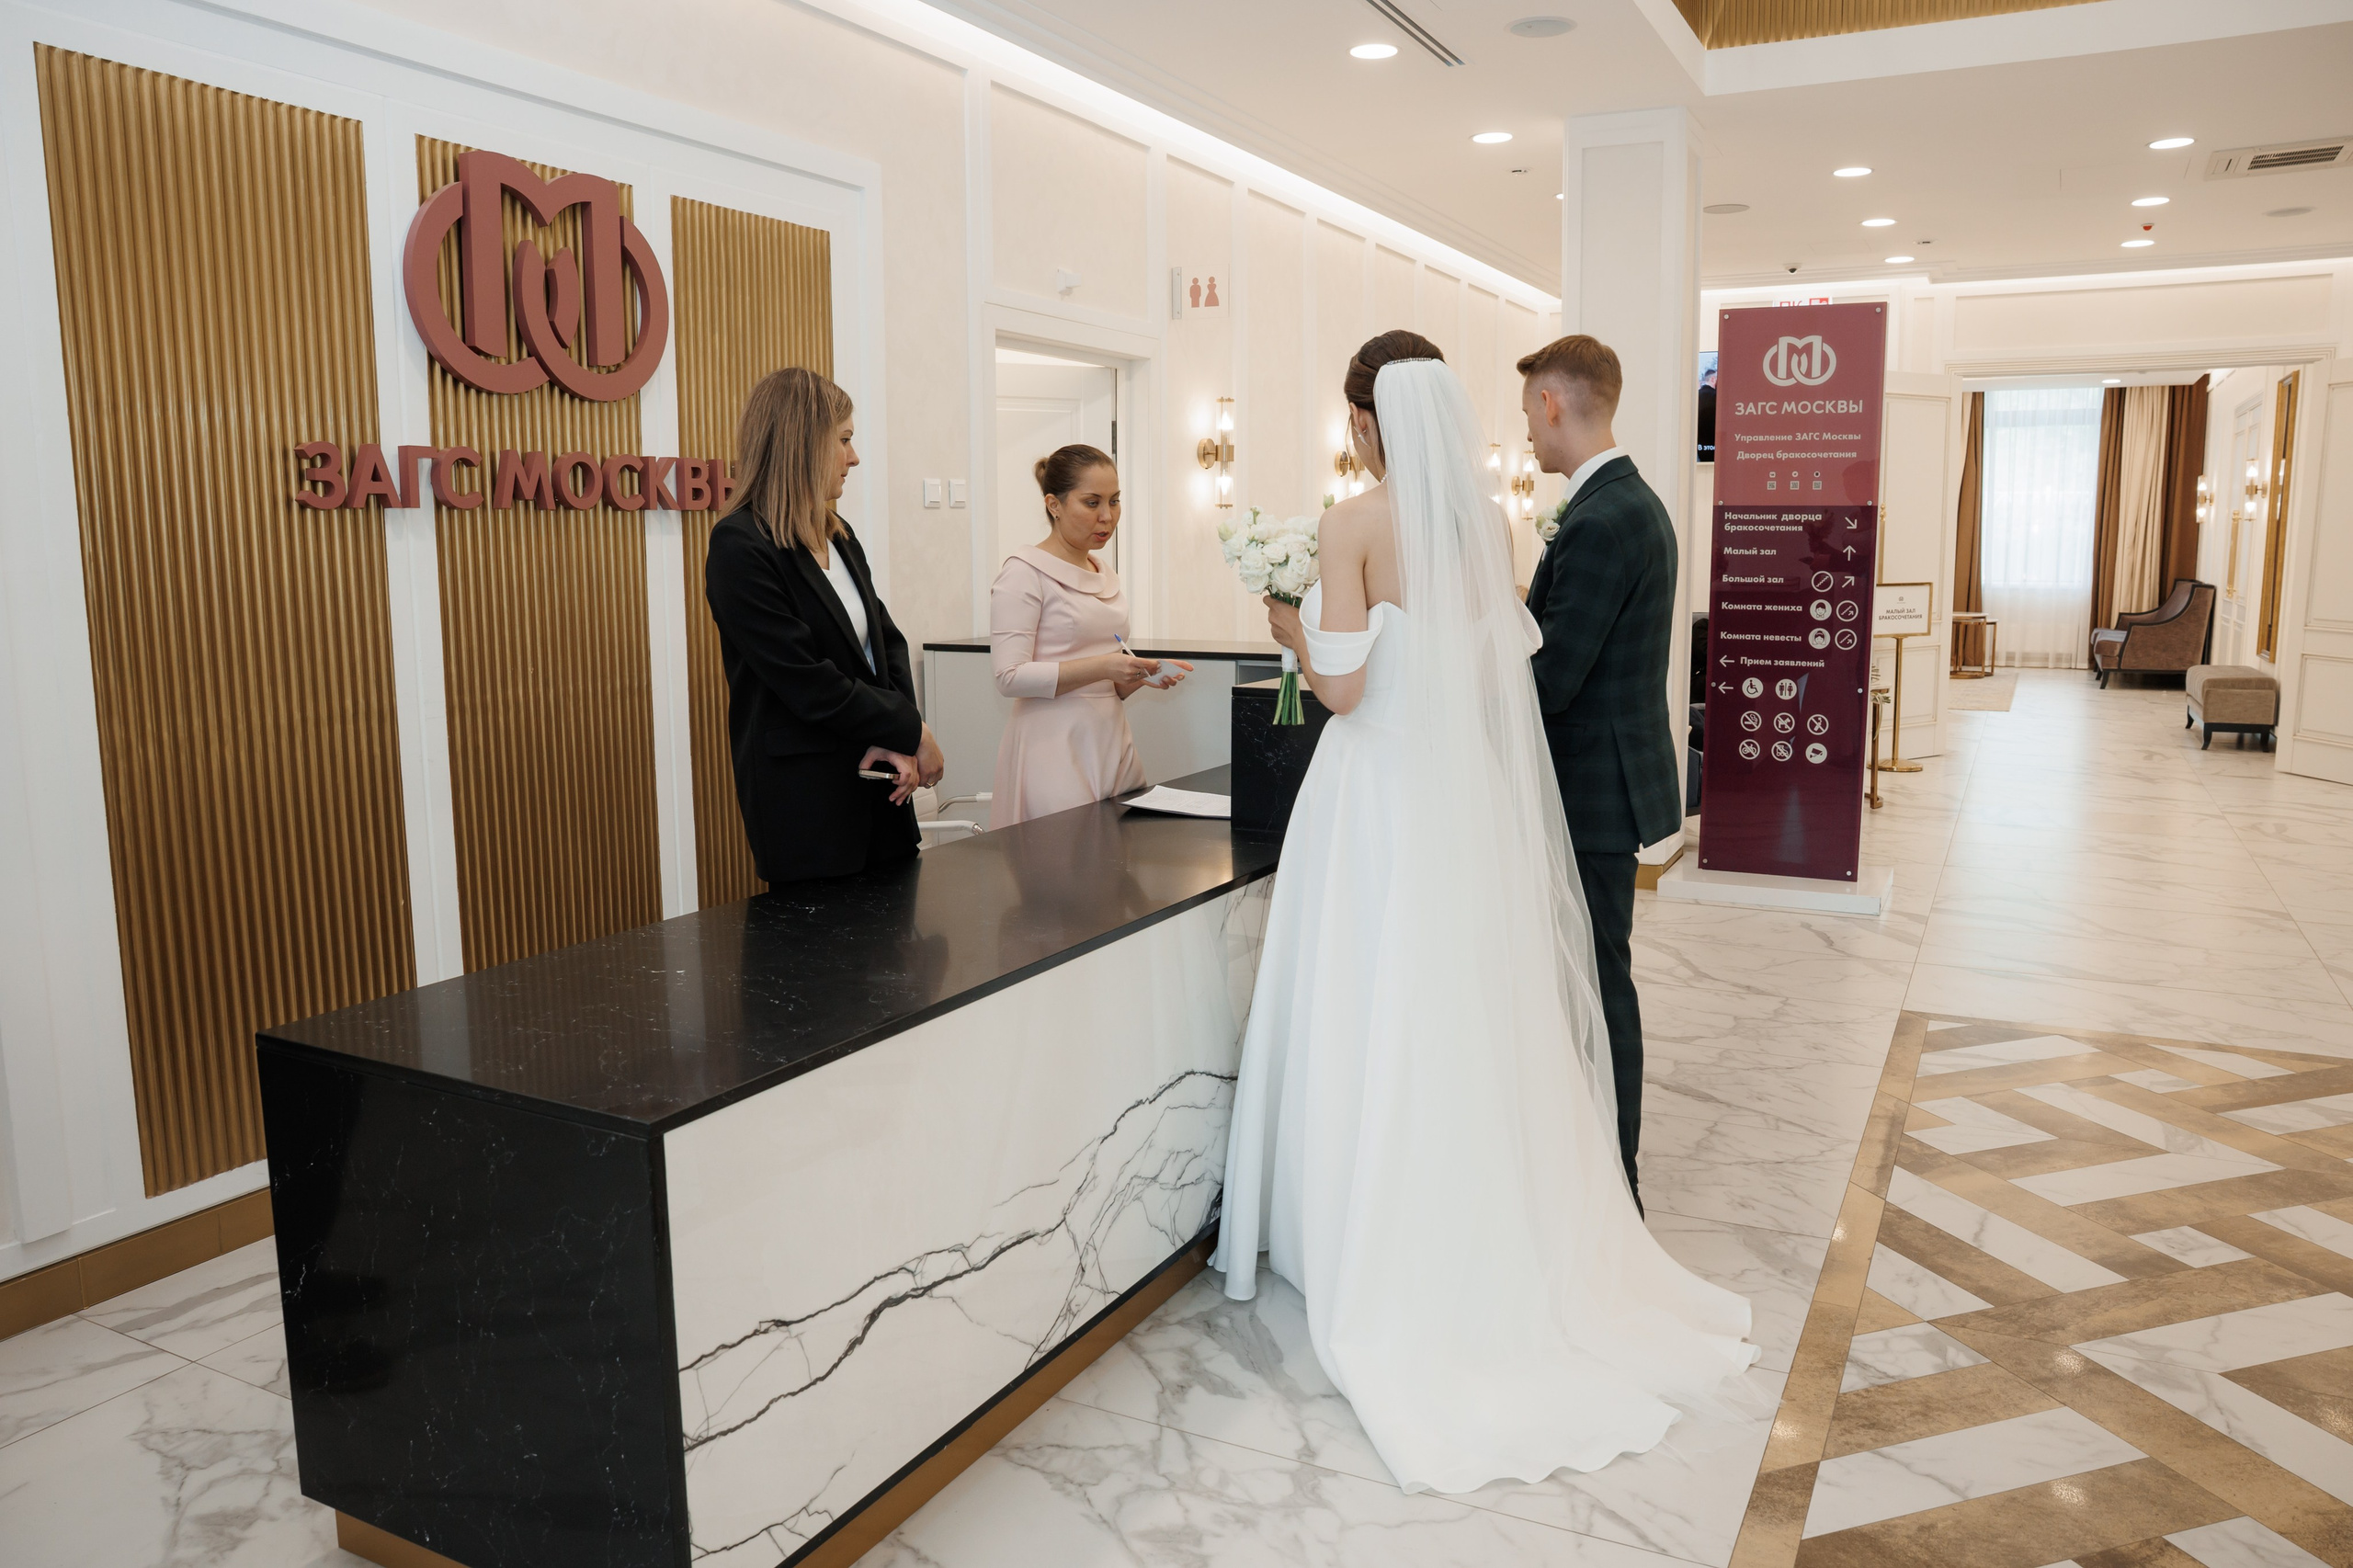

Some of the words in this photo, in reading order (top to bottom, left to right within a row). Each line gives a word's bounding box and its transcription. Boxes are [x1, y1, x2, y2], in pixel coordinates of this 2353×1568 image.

[1734, 402, 1778, 415] ЗАГС
[1781, 400, 1863, 415] МОСКВЫ
[1734, 433, 1793, 443] Управление
[1795, 432, 1820, 441] ЗАГС
[1822, 433, 1861, 441] Москвы
[1736, 450, 1774, 461] Дворец
[1776, 449, 1858, 460] бракосочетания
[294, 441, 484, 510] ЗАГС
[1724, 512, 1778, 520] Начальник
[1780, 513, 1823, 522] дворца
[1724, 522, 1803, 533] бракосочетания
[1723, 547, 1758, 555] Малый
[1722, 574, 1765, 583] Большой
[1722, 601, 1763, 611] Комната
[1720, 631, 1761, 641] Комната
[1740, 656, 1772, 666] Прием
[1773, 659, 1824, 667] заявлений
